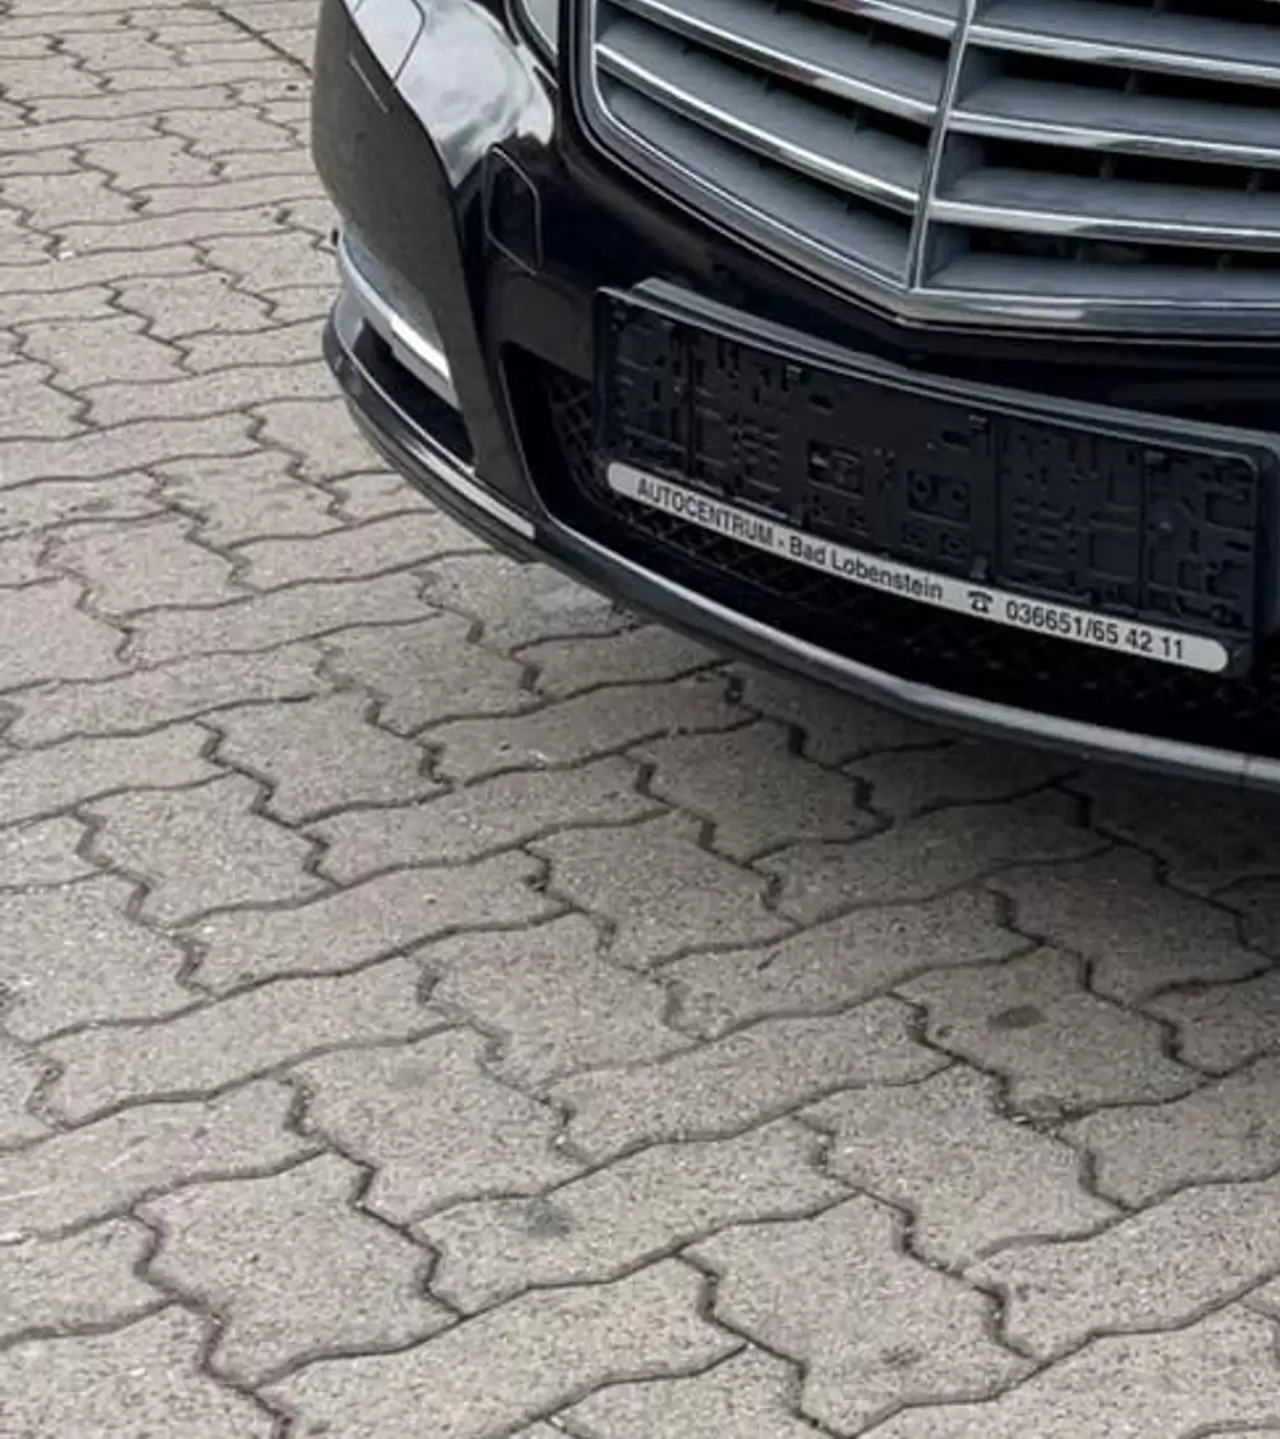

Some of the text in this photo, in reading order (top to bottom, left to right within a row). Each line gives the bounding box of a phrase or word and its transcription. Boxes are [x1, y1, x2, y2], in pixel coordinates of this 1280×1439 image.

[636, 477, 775, 547] AUTOCENTRUM
[789, 535, 828, 566] Bad
[831, 549, 944, 601] Lobenstein
[1005, 599, 1119, 645] 036651/65
[1124, 628, 1153, 653] 42
[1161, 636, 1183, 659] 11
